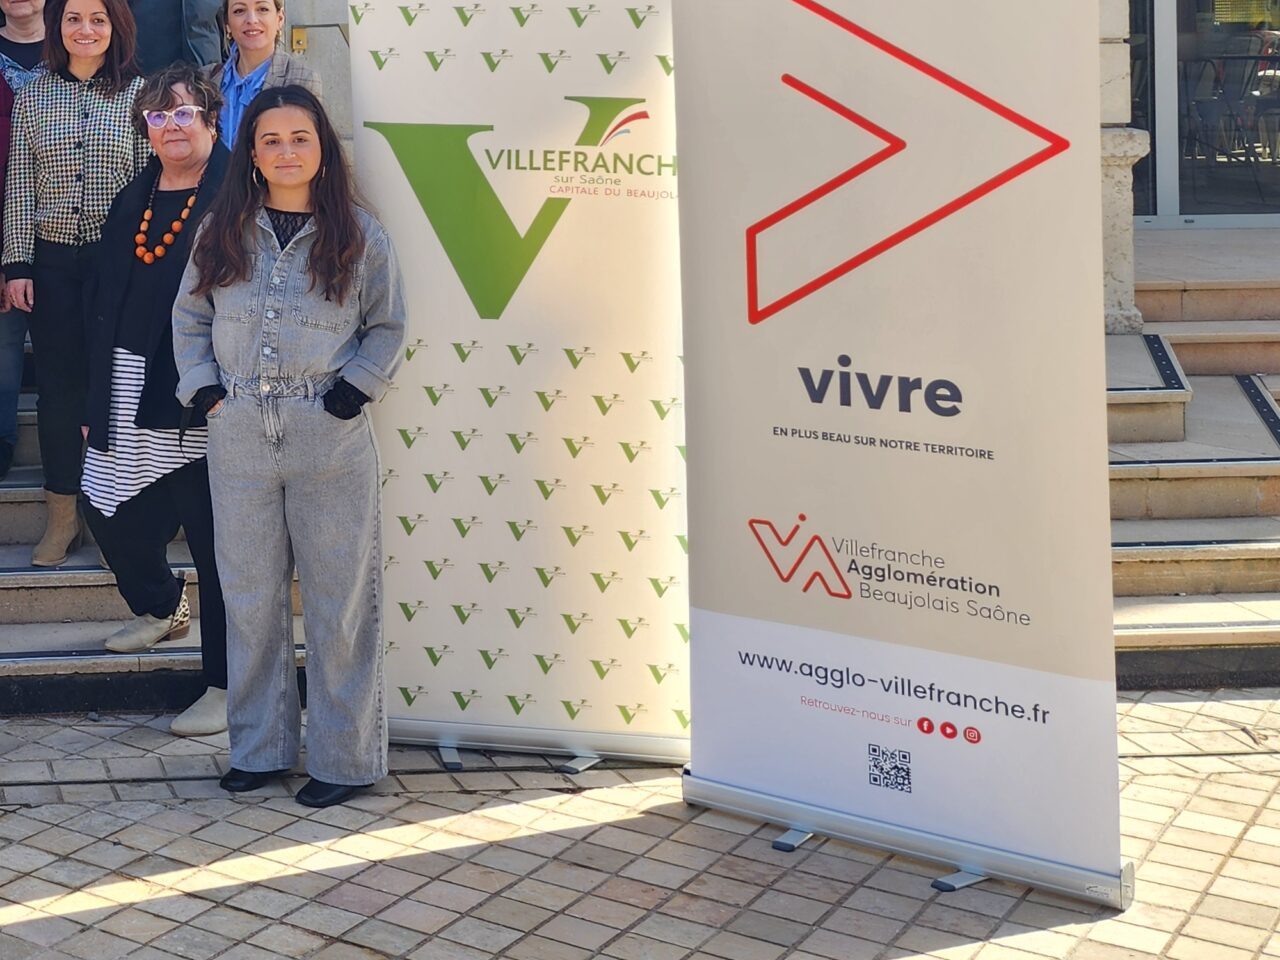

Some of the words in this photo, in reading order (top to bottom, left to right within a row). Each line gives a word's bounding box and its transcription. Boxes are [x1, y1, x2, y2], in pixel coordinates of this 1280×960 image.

[485, 149, 677, 176] VILLEFRANCH
[549, 185, 599, 195] CAPITALE
[604, 188, 621, 196] DU
[626, 189, 678, 200] BEAUJOL
[554, 175, 575, 183] sur
[579, 174, 621, 186] Saône
[798, 354, 963, 417] vivre
[773, 427, 788, 437] EN
[791, 428, 819, 440] PLUS
[821, 431, 851, 443] BEAU
[854, 435, 876, 447] SUR
[880, 439, 920, 452] NOTRE
[923, 443, 994, 461] TERRITOIRE
[832, 537, 945, 569] Villefranche
[847, 559, 1000, 598] Agglomération
[859, 583, 960, 614] Beaujolais
[966, 600, 1030, 626] Saône
[738, 650, 1050, 725] www.agglo-villefranche.fr
[800, 696, 891, 725] Retrouvez-nous
[894, 714, 912, 727] sur
